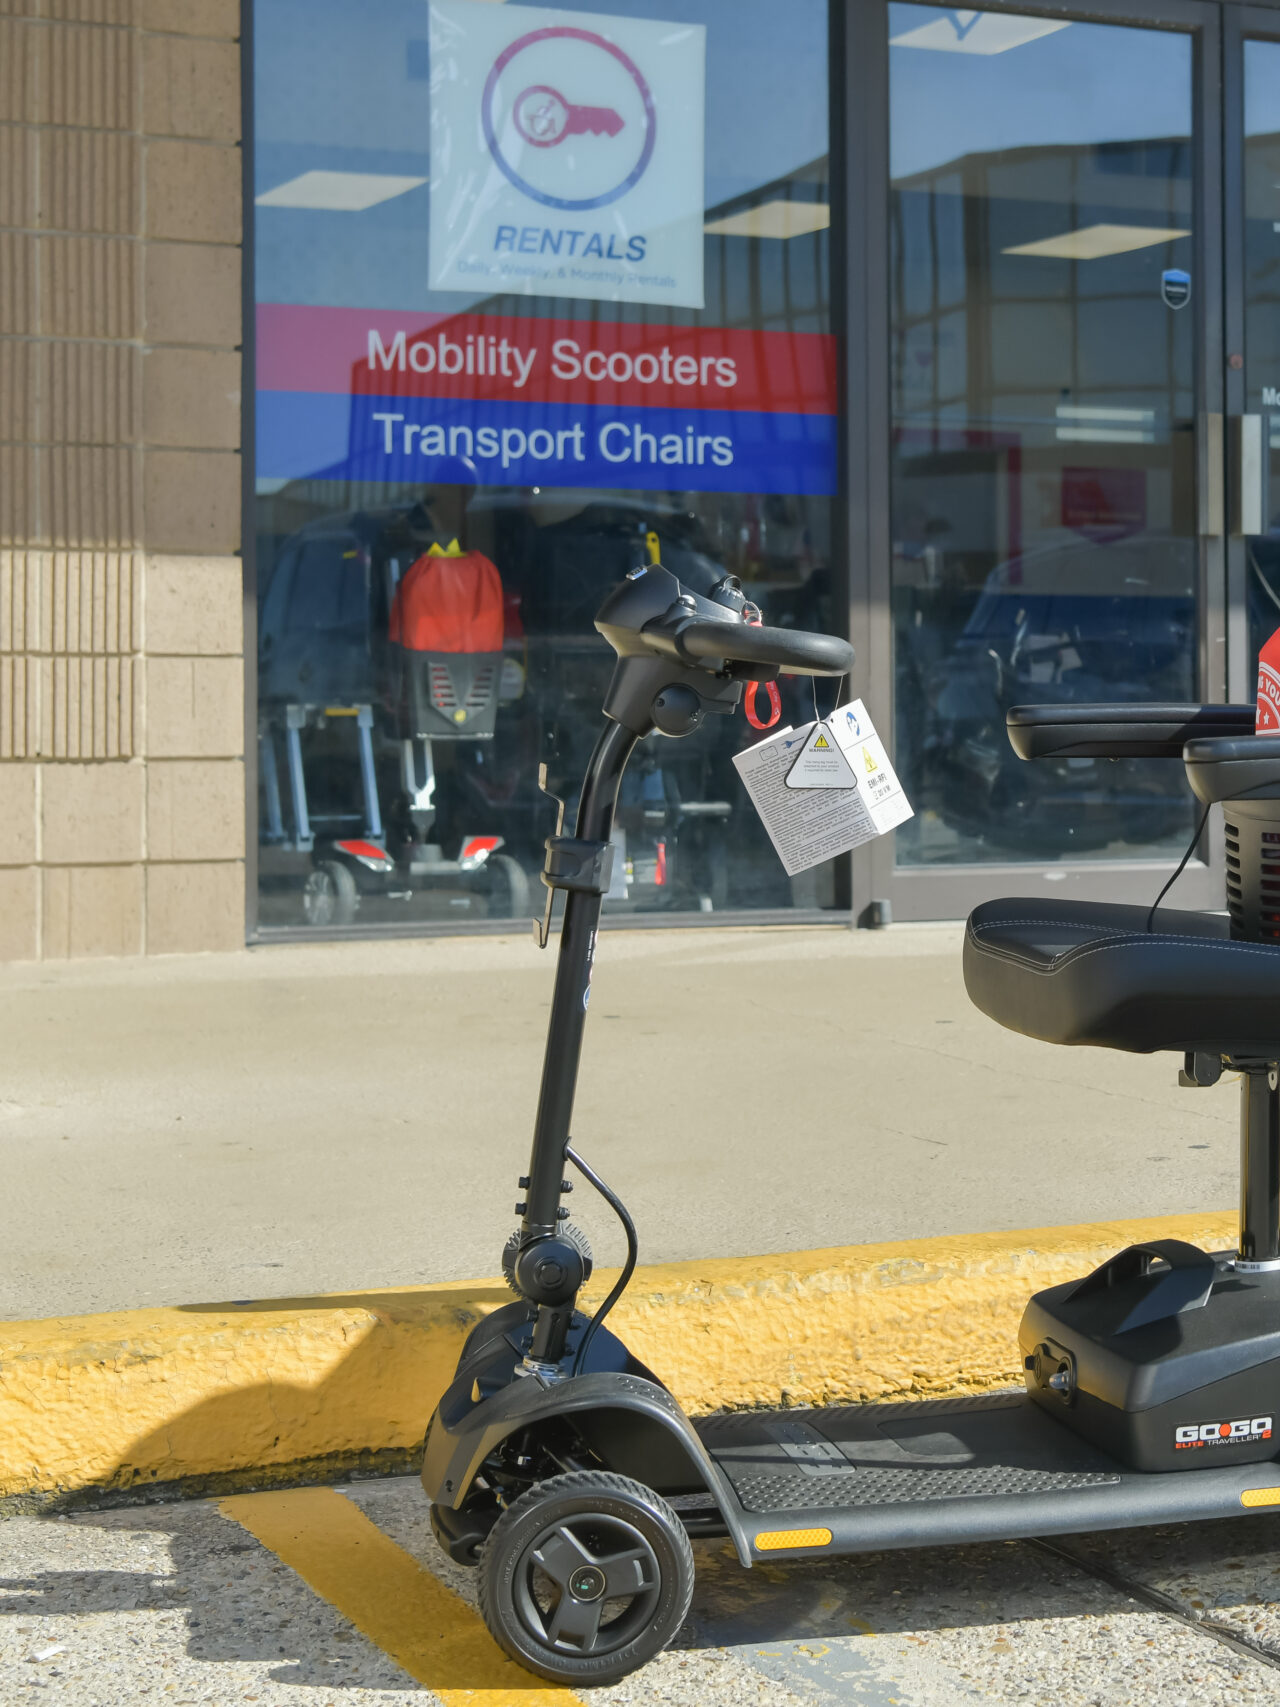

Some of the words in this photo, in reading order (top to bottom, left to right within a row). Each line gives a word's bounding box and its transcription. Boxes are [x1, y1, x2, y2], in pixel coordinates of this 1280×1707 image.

[494, 225, 647, 262] RENTALS
[571, 268, 625, 285] Monthly
[367, 330, 536, 388] Mobility
[551, 338, 738, 388] Scooters
[373, 412, 585, 467] Transport
[600, 421, 734, 466] Chairs
[1175, 1441, 1204, 1449] ELITE
